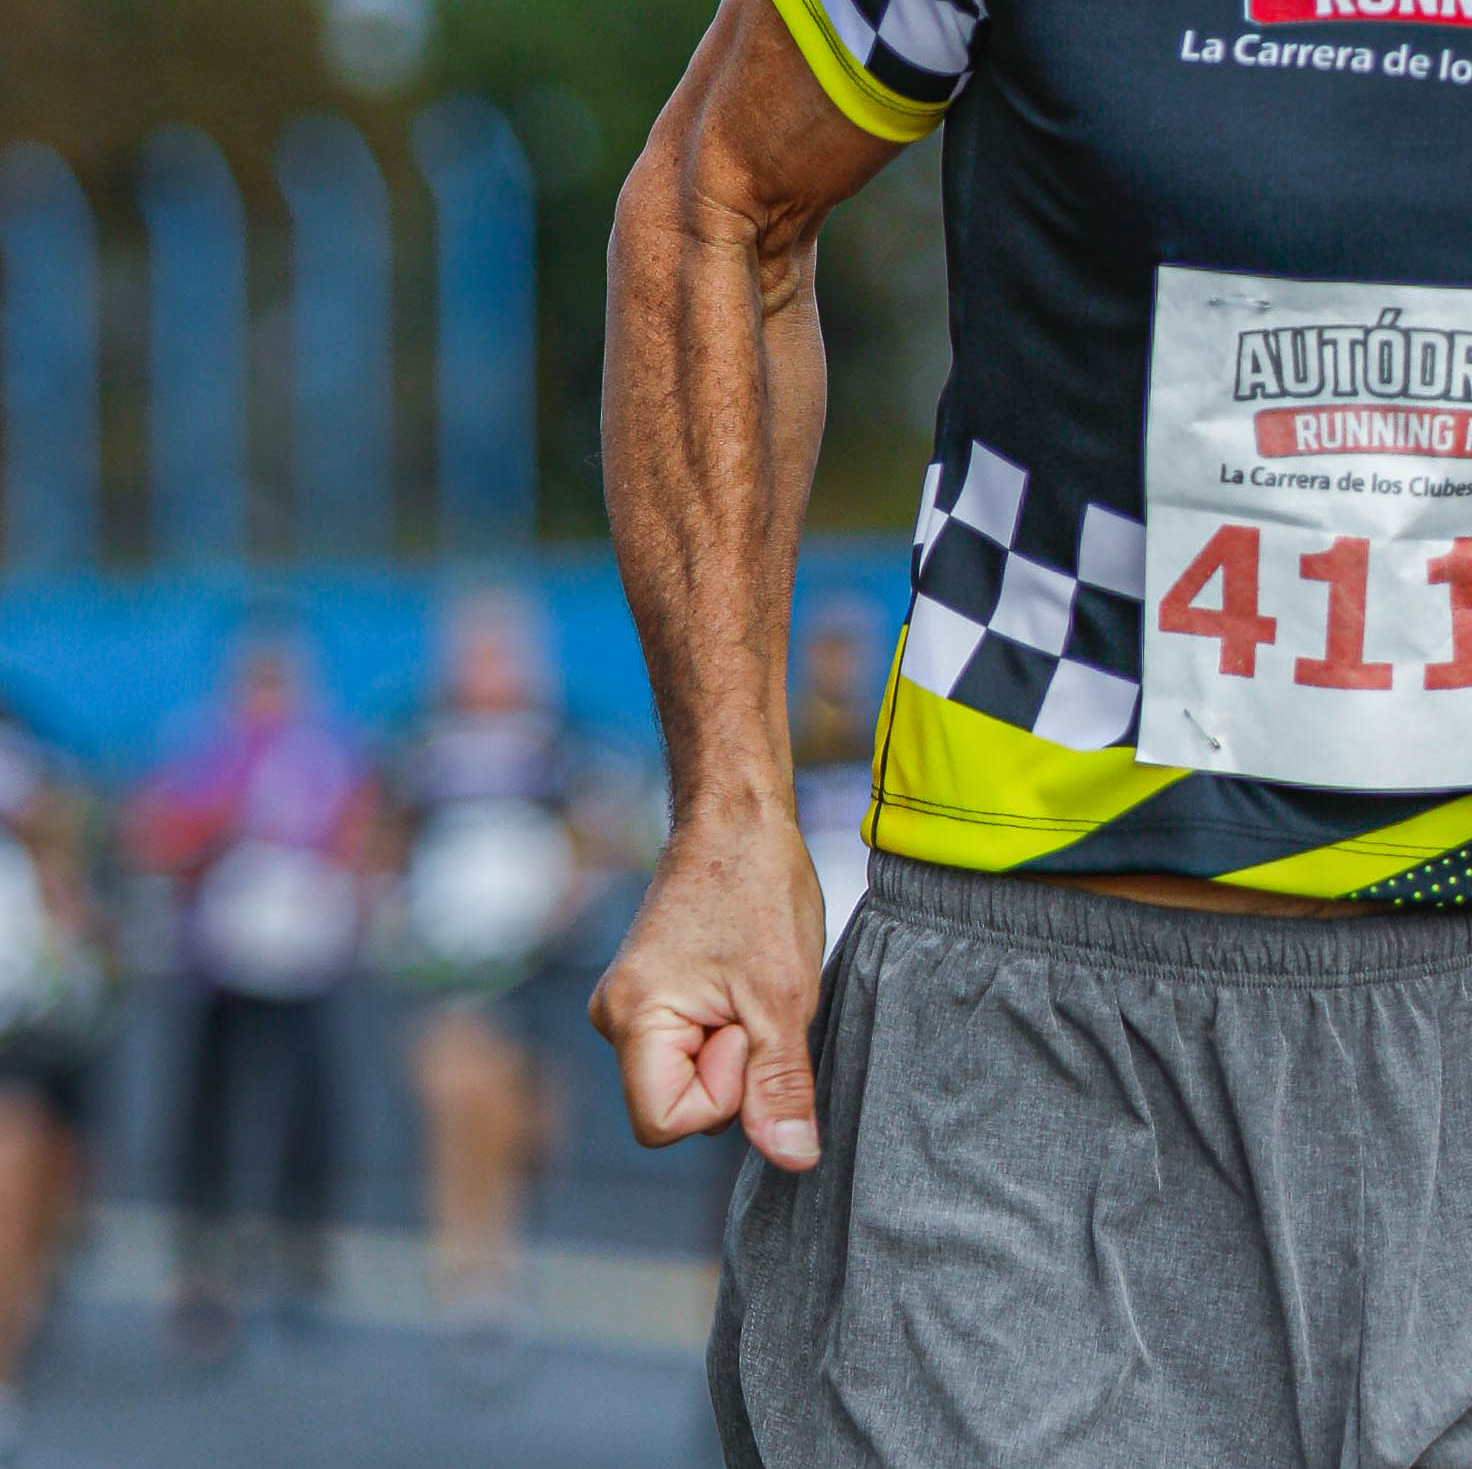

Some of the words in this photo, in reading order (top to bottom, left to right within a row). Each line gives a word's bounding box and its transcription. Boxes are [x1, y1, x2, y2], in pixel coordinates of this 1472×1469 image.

[1180, 30, 1225, 63] La
[1233, 33, 1375, 73] Carrera
[1383, 43, 1431, 78] de
[1296, 411, 1455, 452] RUNNING
[1219, 463, 1244, 485] La
[1249, 466, 1331, 492] Carrera
[1337, 471, 1365, 494] de
[1371, 473, 1402, 496] los
